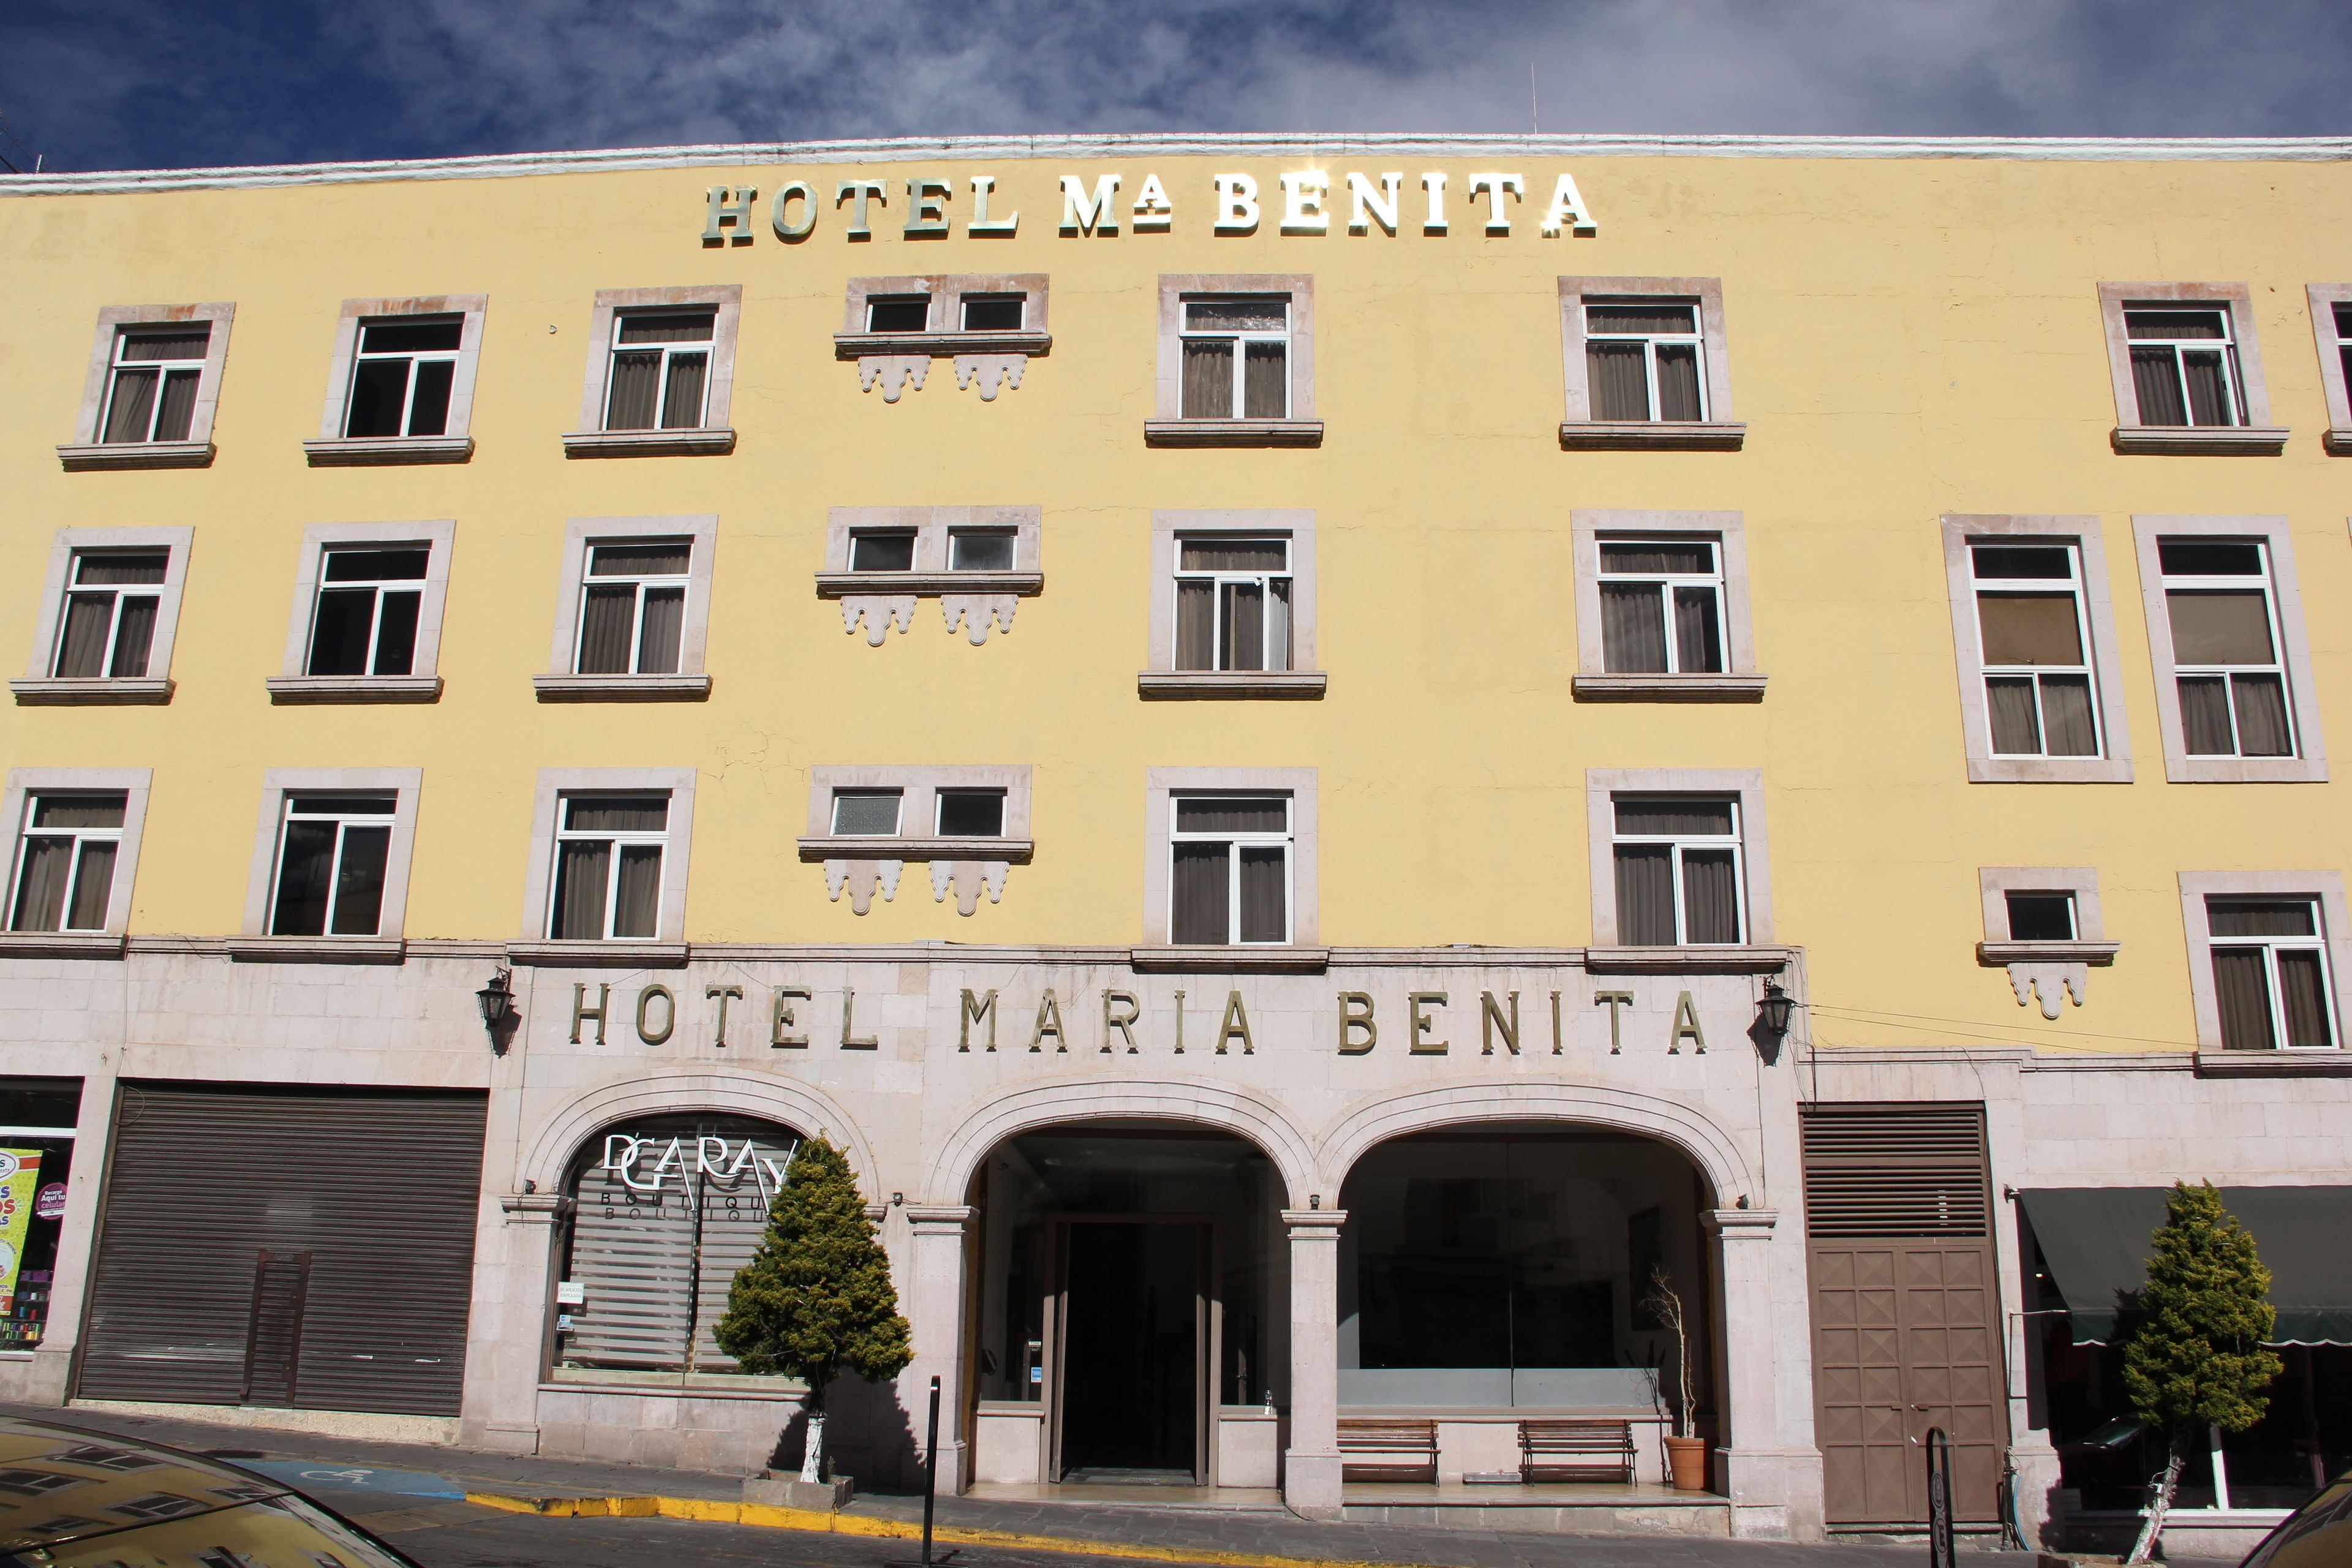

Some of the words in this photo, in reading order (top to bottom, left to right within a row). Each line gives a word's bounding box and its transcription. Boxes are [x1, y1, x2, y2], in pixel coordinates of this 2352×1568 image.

[701, 176, 1019, 239] HOTEL
[1213, 172, 1598, 231] BENITA
[570, 982, 878, 1044] HOTEL
[957, 987, 1254, 1049] MARIA
[1338, 990, 1708, 1050] BENITA
[601, 1193, 761, 1208] BOUTIQU
